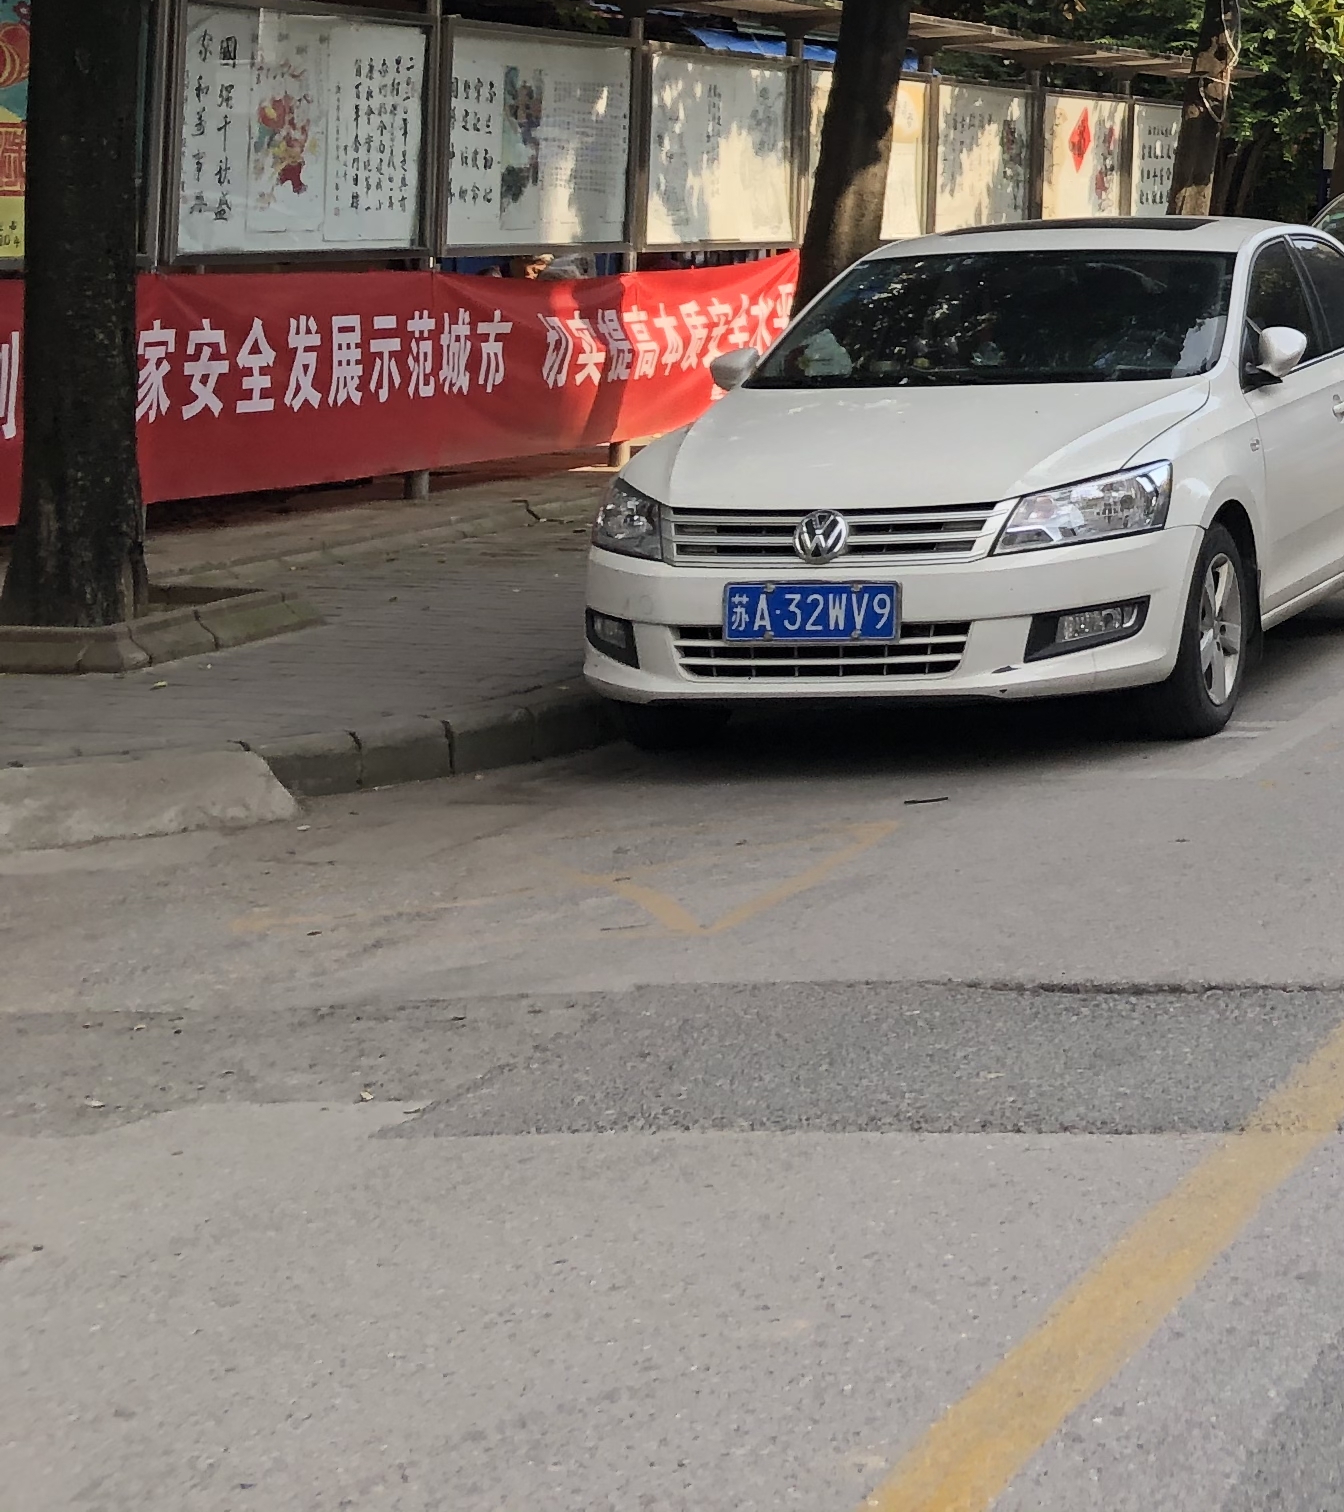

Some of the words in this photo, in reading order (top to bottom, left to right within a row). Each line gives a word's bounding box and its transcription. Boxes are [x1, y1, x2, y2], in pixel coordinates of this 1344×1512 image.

[136, 308, 512, 423] 家安全发展示范城市
[731, 593, 891, 631] 苏A·32WV9
